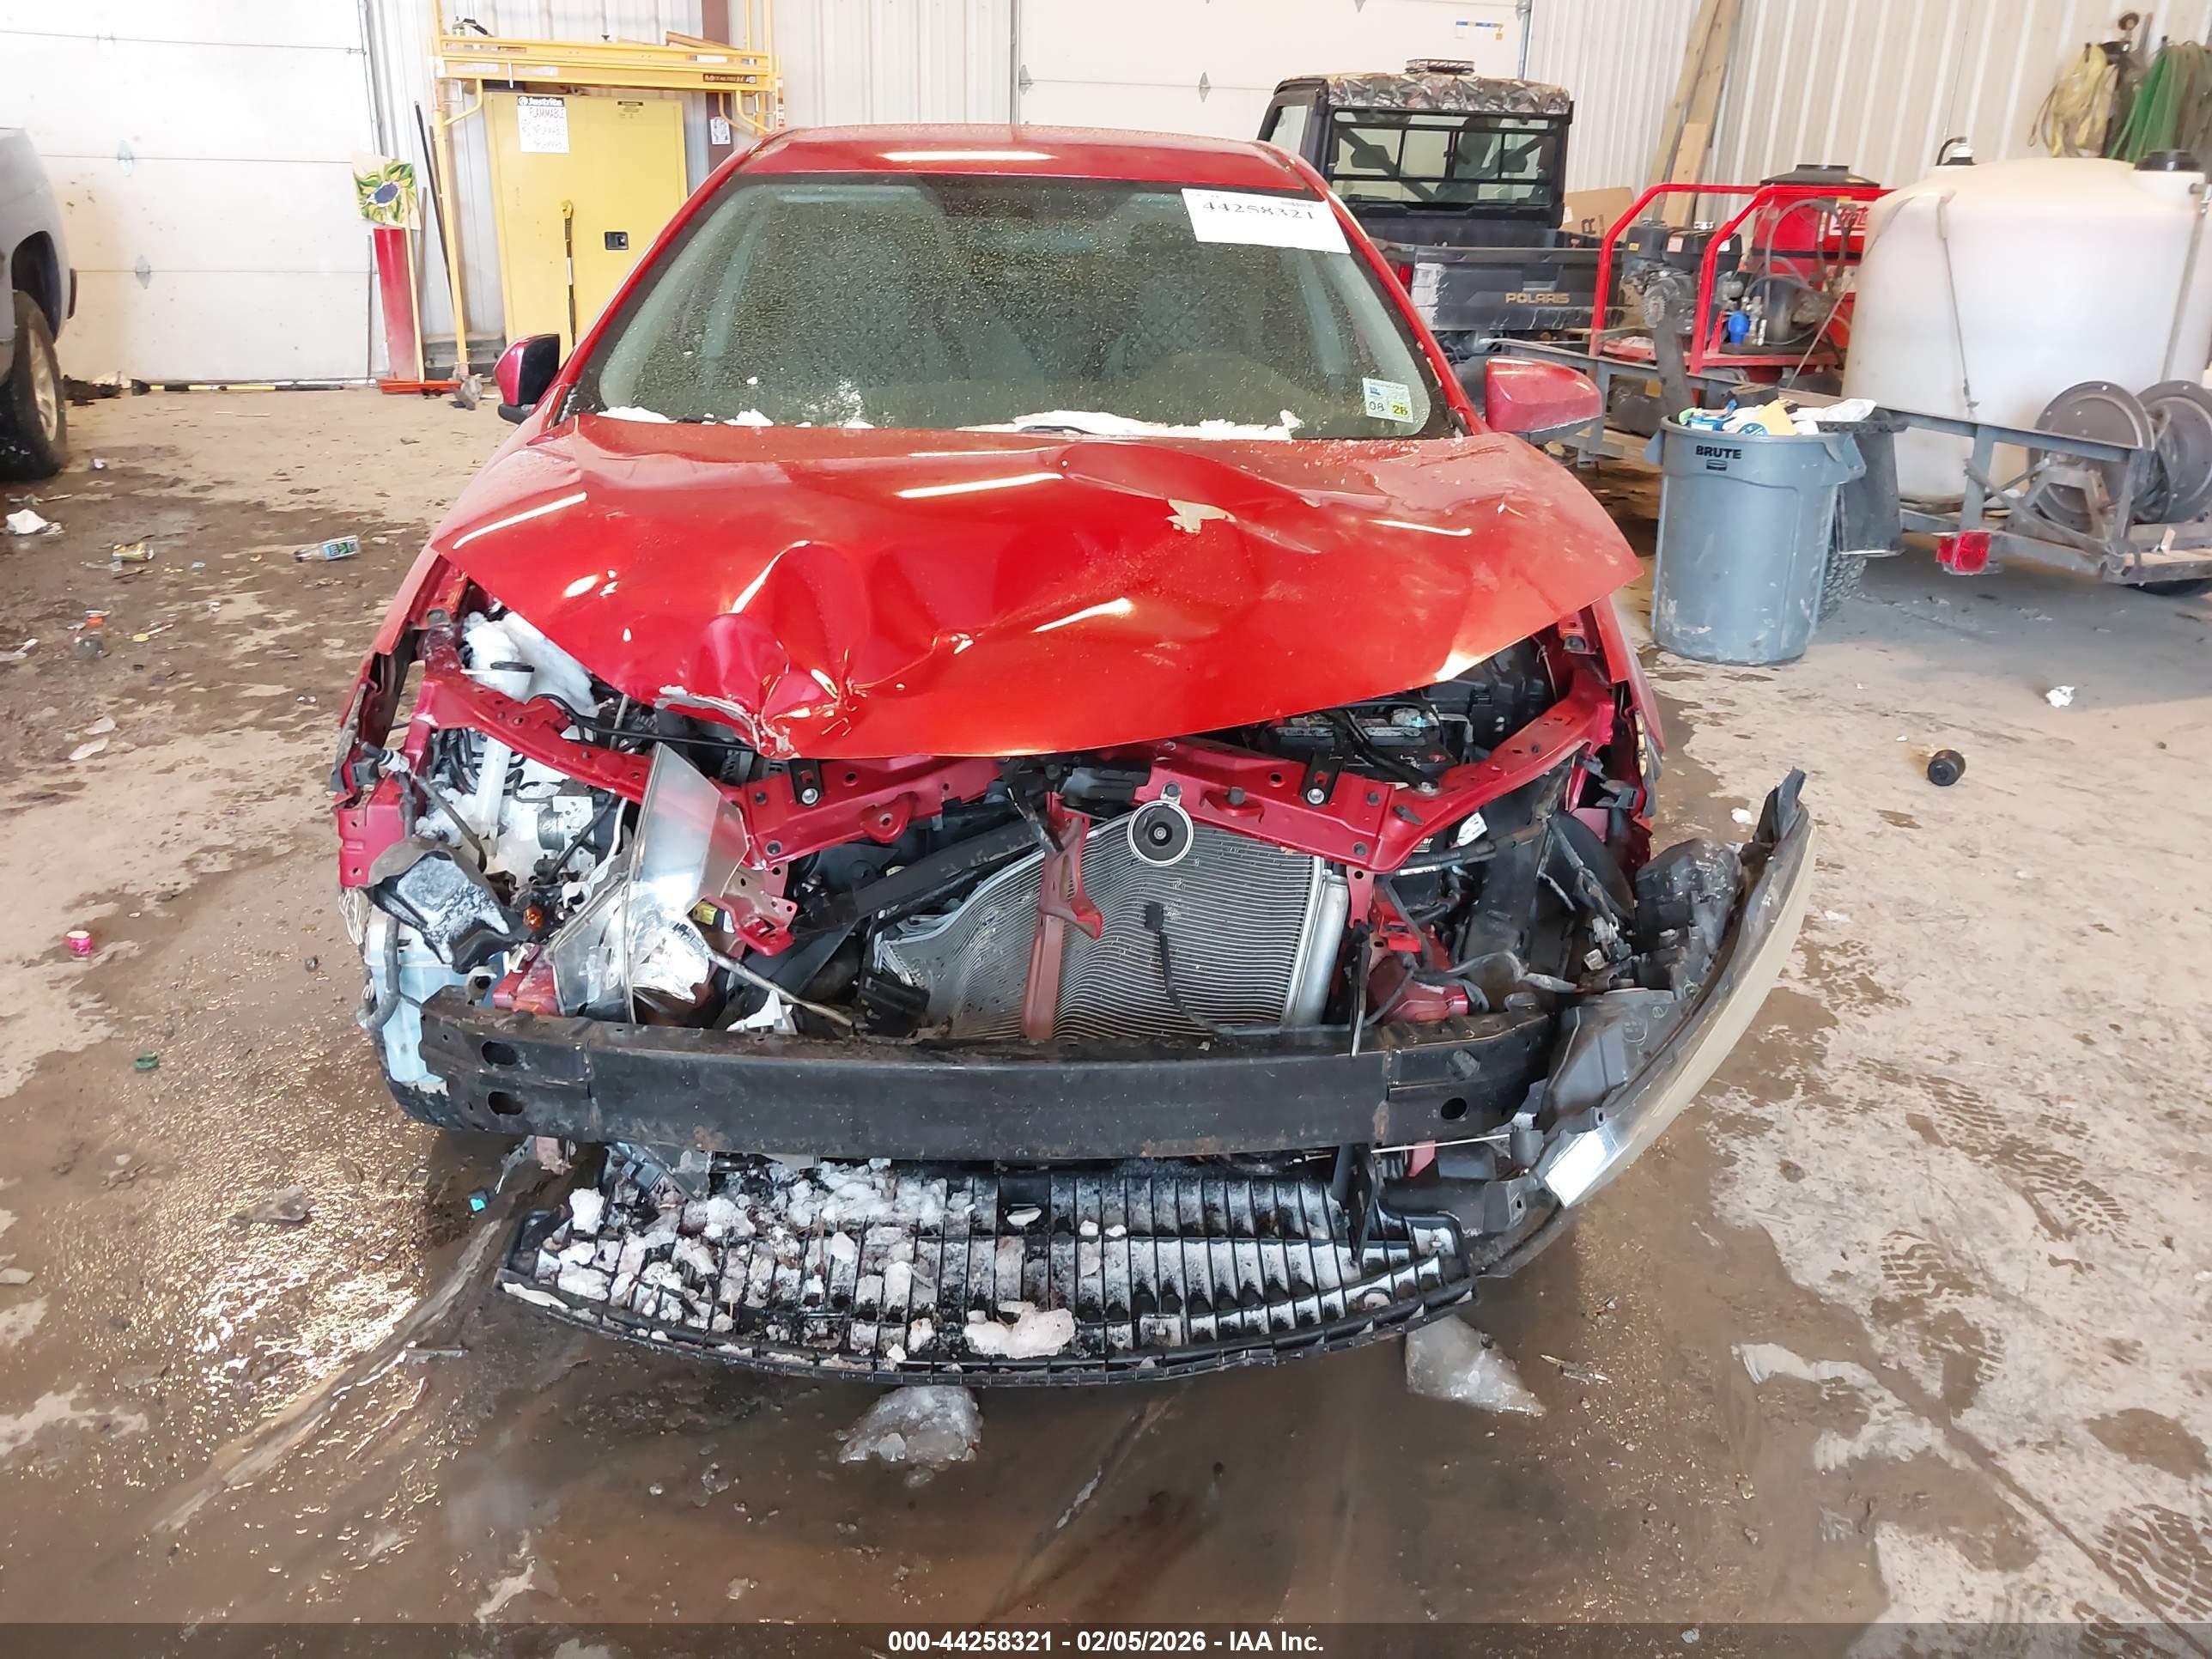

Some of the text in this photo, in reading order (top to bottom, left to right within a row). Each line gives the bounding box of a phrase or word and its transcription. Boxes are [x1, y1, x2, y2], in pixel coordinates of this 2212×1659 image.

[1202, 200, 1315, 221] 44258321
[1504, 292, 1571, 304] POLARIS
[1369, 401, 1408, 416] 08 26
[1695, 445, 1742, 459] BRUTE
